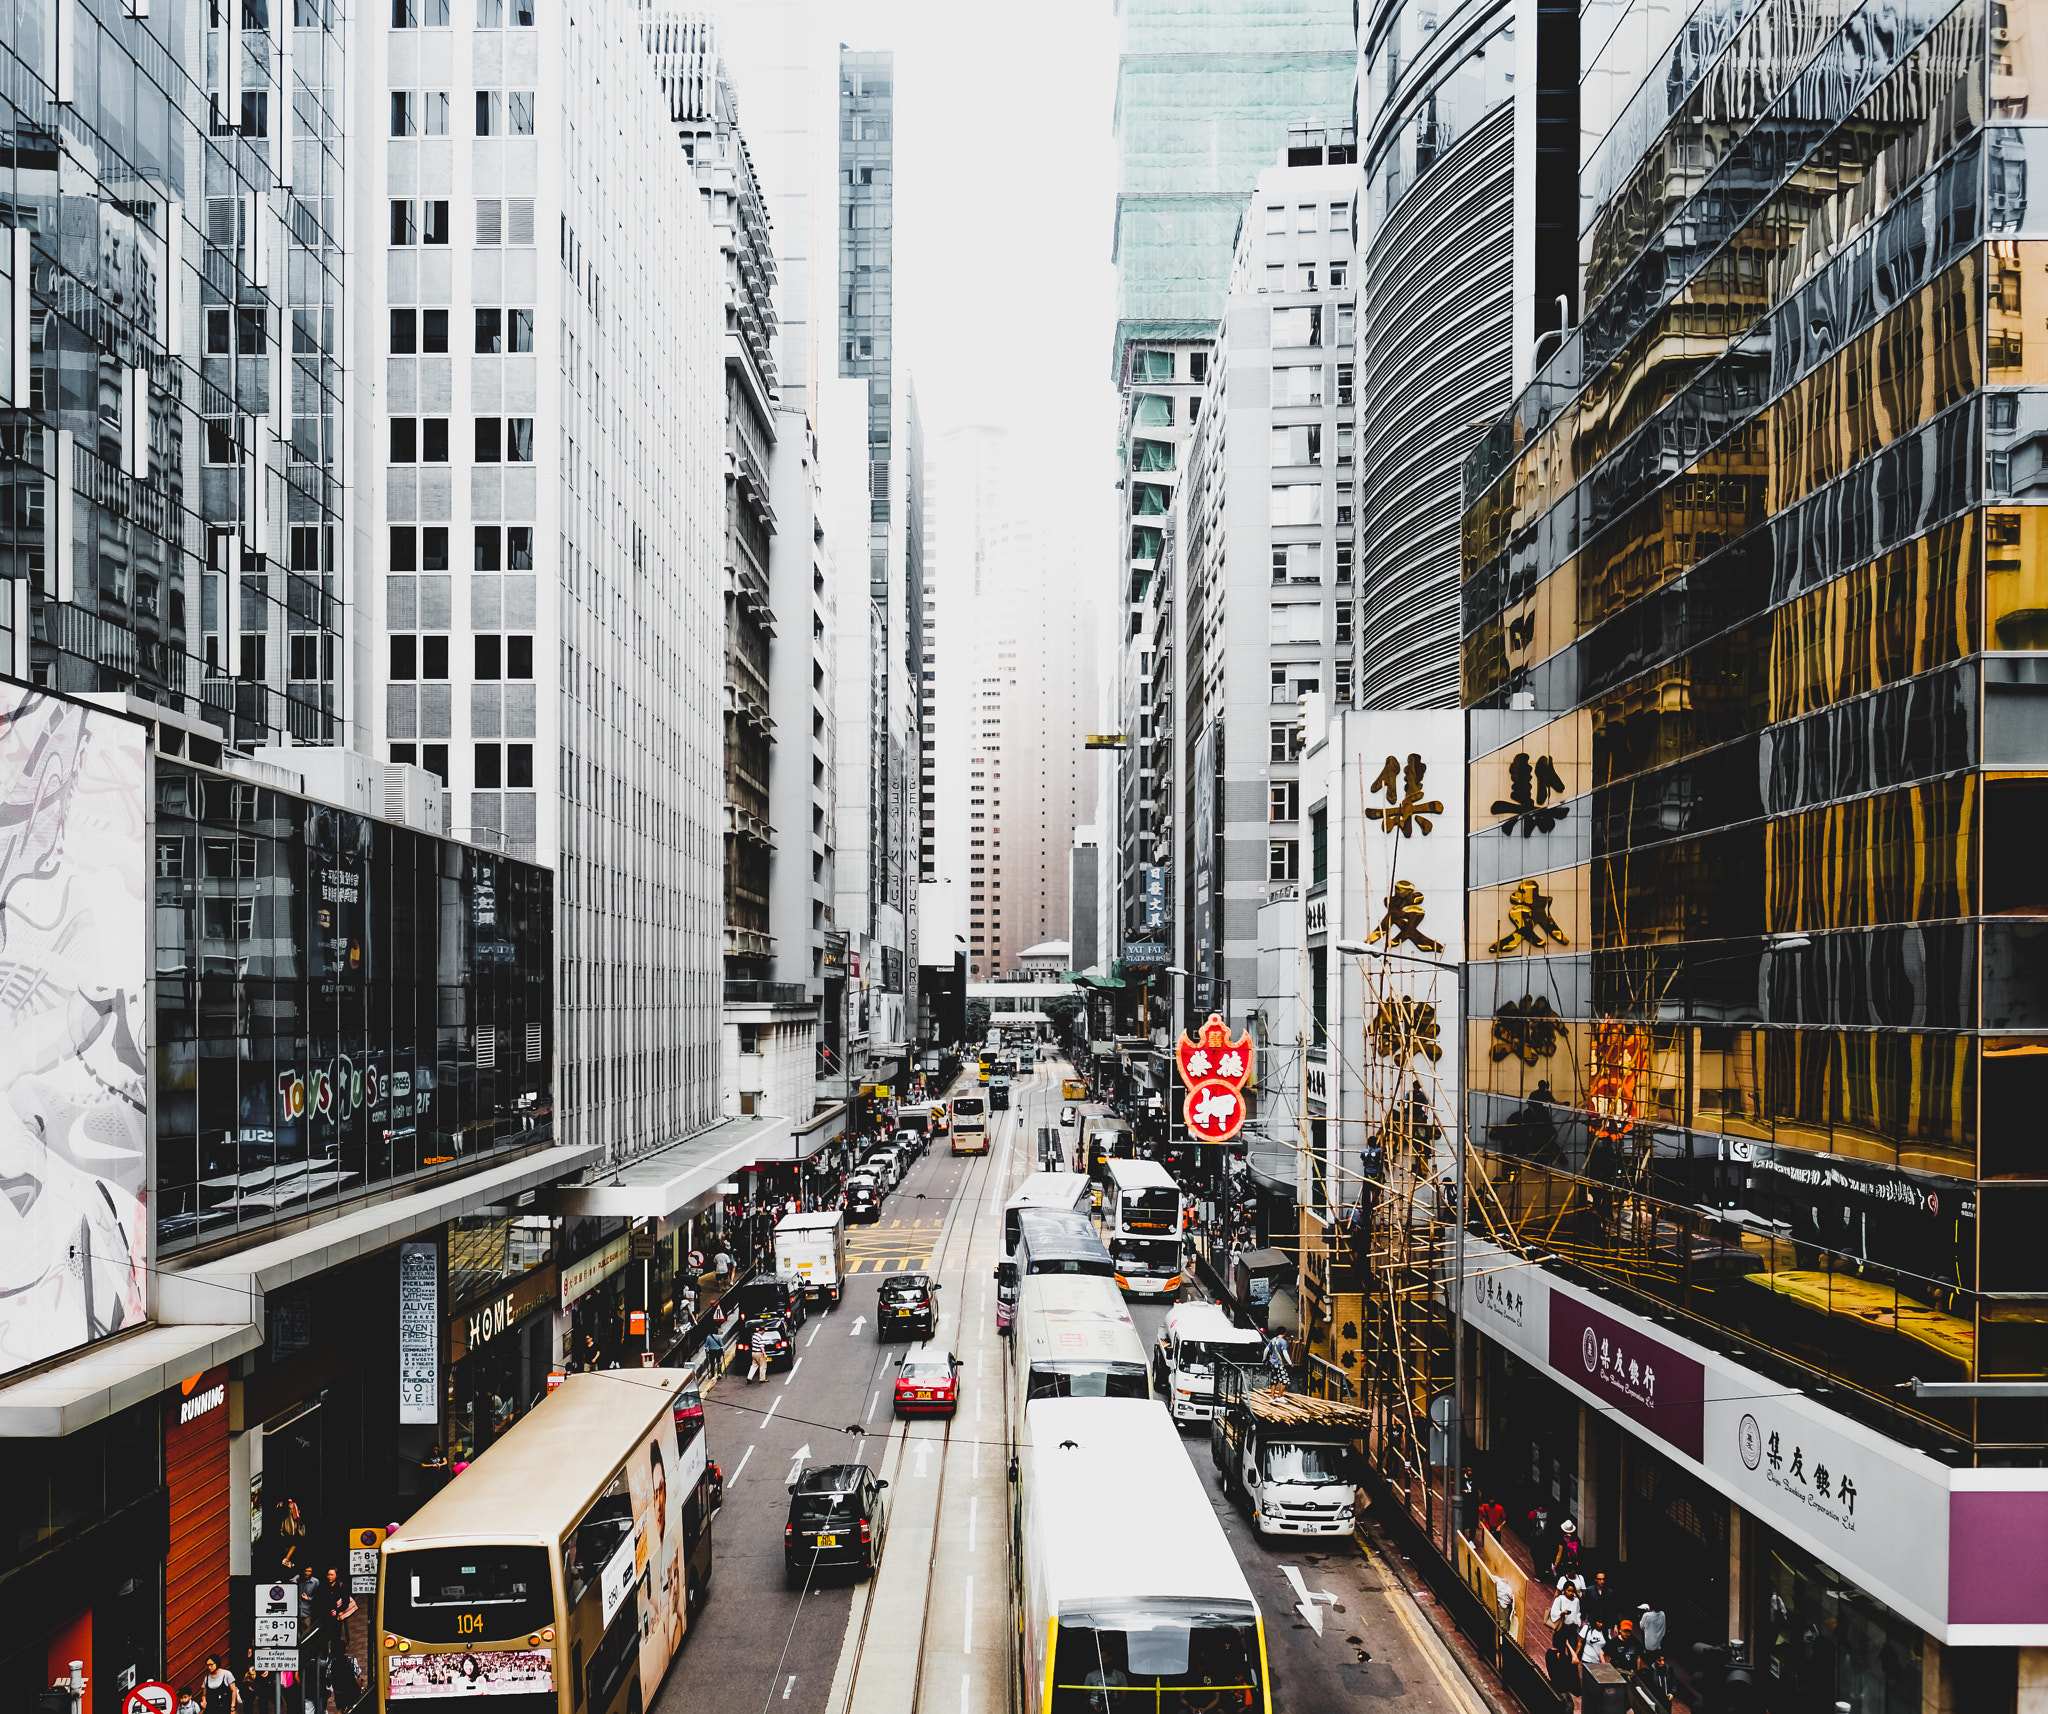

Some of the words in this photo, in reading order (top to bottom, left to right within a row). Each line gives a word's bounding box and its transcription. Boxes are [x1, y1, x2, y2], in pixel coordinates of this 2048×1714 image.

[909, 875, 917, 915] FUR
[909, 929, 917, 998] STORE
[1128, 945, 1143, 954] YAT
[1148, 945, 1162, 954] FAT
[372, 1110, 387, 1123] come
[417, 1092, 431, 1114] 2/F
[1193, 1087, 1237, 1132] 押
[403, 1302, 435, 1311] ALIVE
[470, 1293, 514, 1351] HOME
[1600, 1338, 1656, 1397] 集友銀行
[180, 1383, 225, 1425] RUNNING
[1766, 1430, 1857, 1516] 集友銀行
[1783, 1478, 1806, 1504] Banking
[1808, 1493, 1840, 1523] Corporation
[271, 1621, 295, 1630] 8-10
[271, 1634, 289, 1642] 4-7
[457, 1613, 483, 1634] 104
